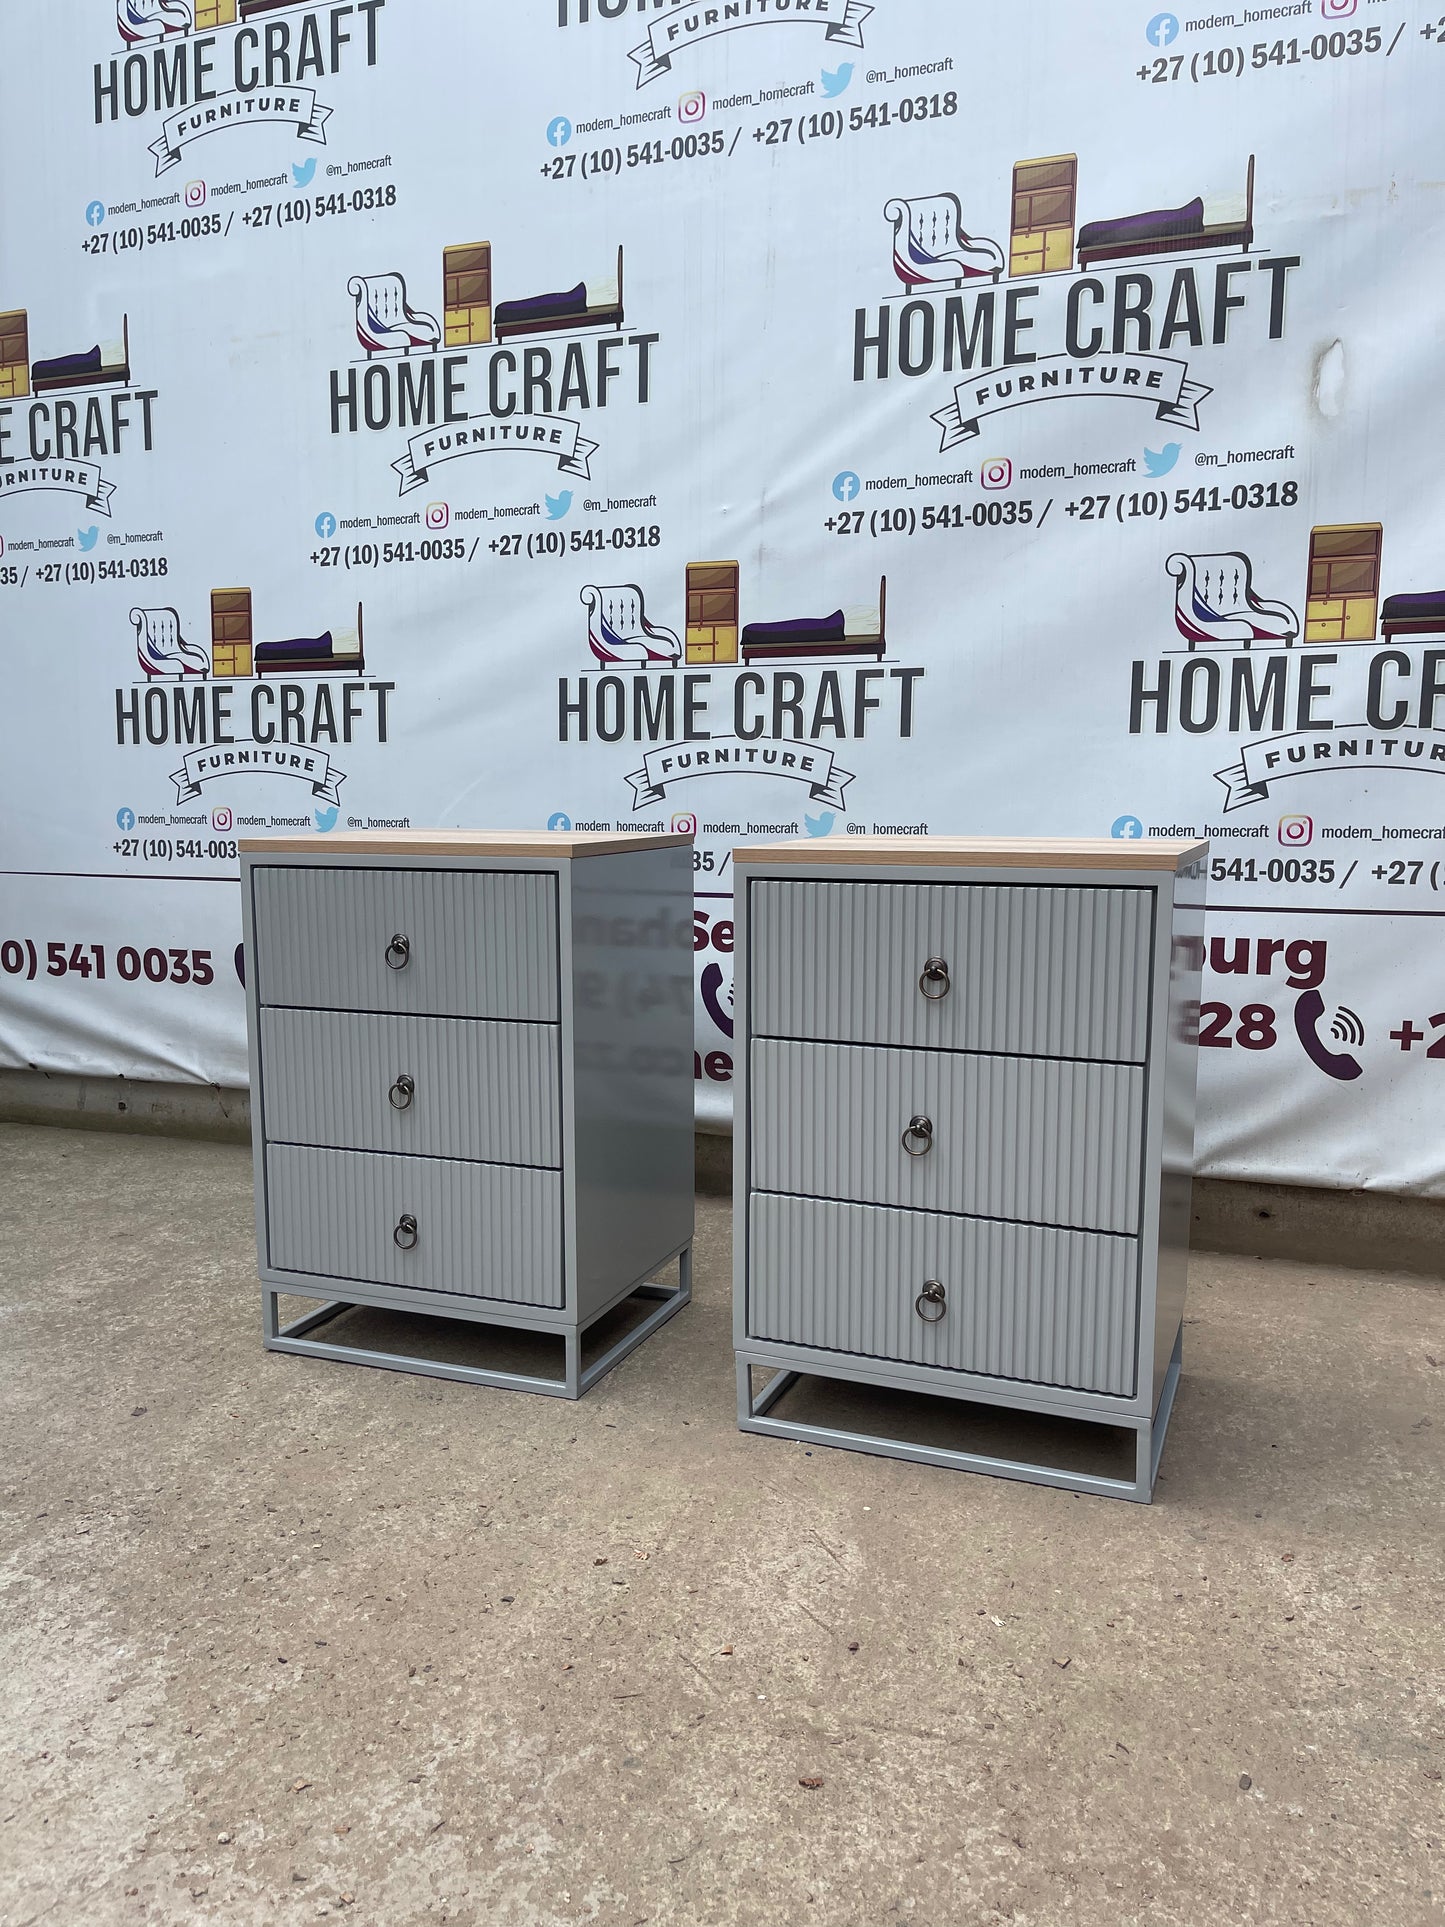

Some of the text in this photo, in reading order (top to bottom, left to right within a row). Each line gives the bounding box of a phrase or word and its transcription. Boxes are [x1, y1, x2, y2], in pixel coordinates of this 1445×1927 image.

[667, 0, 829, 41] FURNITURE
[94, 0, 386, 124] HOME CRAFT
[865, 57, 954, 84] @m_homecraft
[1136, 56, 1184, 83] +27
[1190, 47, 1245, 83] (10)
[1251, 26, 1382, 69] 541-0035
[177, 97, 301, 137] FURNITURE
[540, 155, 577, 180] +27
[581, 147, 622, 179] (10)
[626, 130, 725, 167] 541-0035
[752, 119, 793, 145] +27
[799, 110, 843, 145] (10)
[849, 91, 958, 132] 541-0318
[326, 155, 392, 178] @m_homecraft
[82, 234, 109, 255] +27
[113, 227, 144, 254] (10)
[147, 214, 222, 245] 541-0035
[242, 206, 272, 227] +27
[277, 198, 312, 227] (10)
[315, 184, 397, 218] 541-0318
[853, 256, 1301, 382] HOME CRAFT
[330, 333, 660, 434] HOME CRAFT
[976, 367, 1163, 405] FURNITURE
[29, 390, 158, 462] CRAFT
[424, 425, 563, 457] FURNITURE
[1194, 445, 1295, 468] @m_homecraft
[0, 468, 88, 487] RNITURE
[583, 494, 657, 514] @m_homecraft
[824, 510, 865, 535] +27
[870, 506, 916, 537] (10)
[922, 500, 1033, 530] 541-0035
[1065, 495, 1109, 521] +27
[1116, 490, 1167, 523] (10)
[1174, 480, 1299, 515] 541-0318
[107, 530, 163, 546] @m_homecraft
[310, 547, 341, 567] +27
[344, 544, 379, 569] (10)
[383, 538, 465, 564] 541-0035
[489, 534, 522, 556] +27
[527, 531, 565, 558] (10)
[570, 525, 661, 553] 541-0318
[36, 563, 62, 584] +27
[65, 561, 95, 585] (10)
[98, 557, 168, 581] 541-0318
[115, 682, 395, 745] HOME CRAFT
[558, 667, 925, 742] HOME CRAFT
[1129, 653, 1338, 734] HOME
[197, 750, 315, 773] FURNITURE
[661, 748, 815, 773] FURNITURE
[347, 816, 410, 830] @m_homecraft
[113, 838, 240, 861] +27 (10) 541-003
[1210, 858, 1335, 883] 541-0035
[1371, 861, 1424, 885] +27
[46, 942, 106, 979] 541
[117, 946, 214, 985] 0035
[1201, 937, 1327, 989] urg
